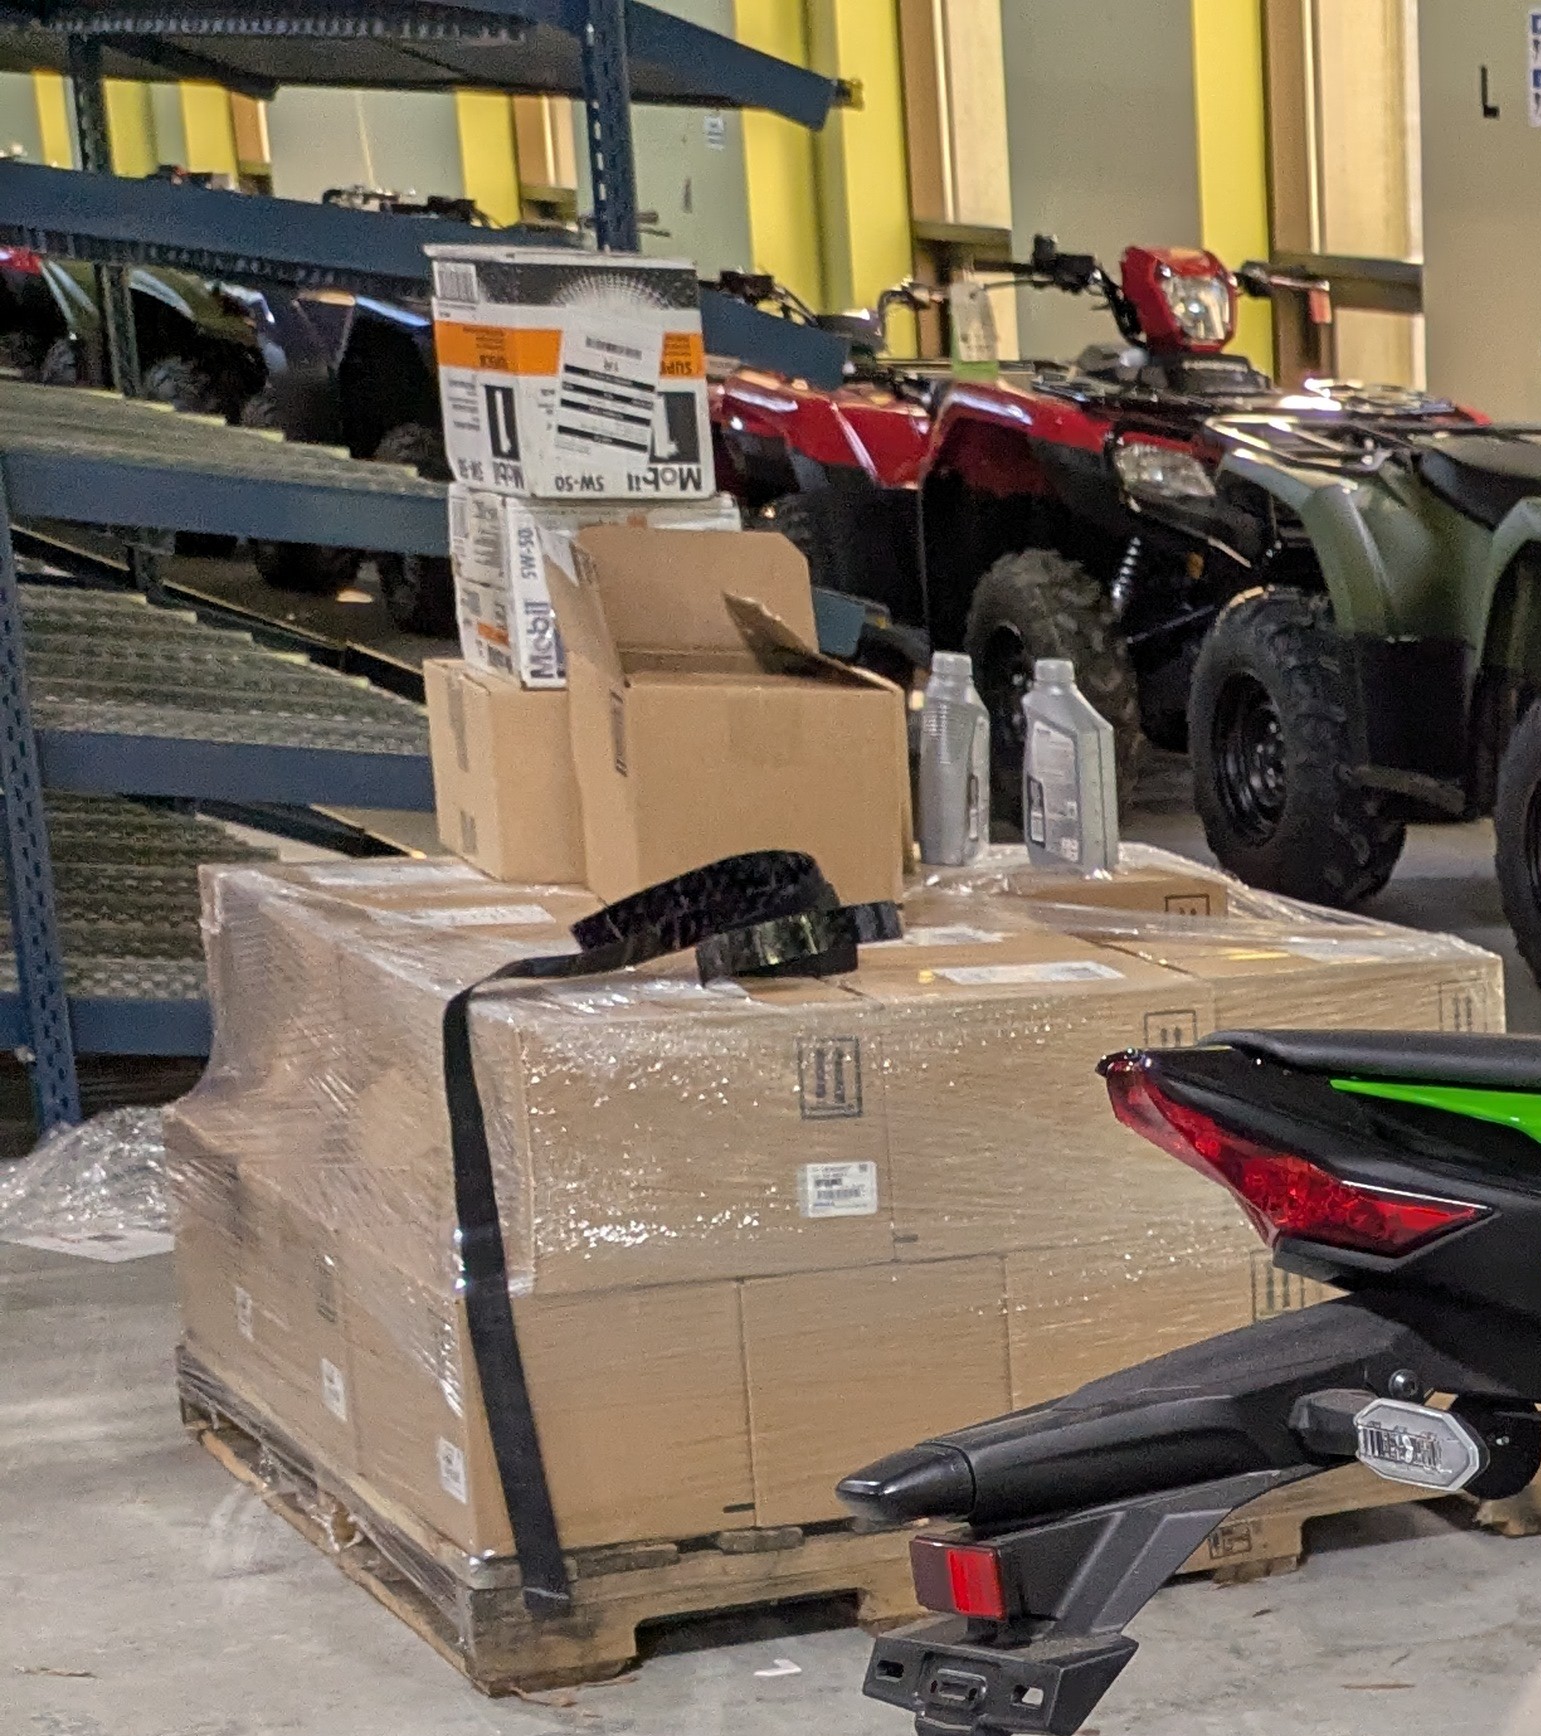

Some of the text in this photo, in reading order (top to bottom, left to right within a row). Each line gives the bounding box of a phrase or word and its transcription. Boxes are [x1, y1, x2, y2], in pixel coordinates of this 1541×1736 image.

[554, 466, 702, 492] Mobil 5W-50
[524, 600, 555, 679] Mobil
